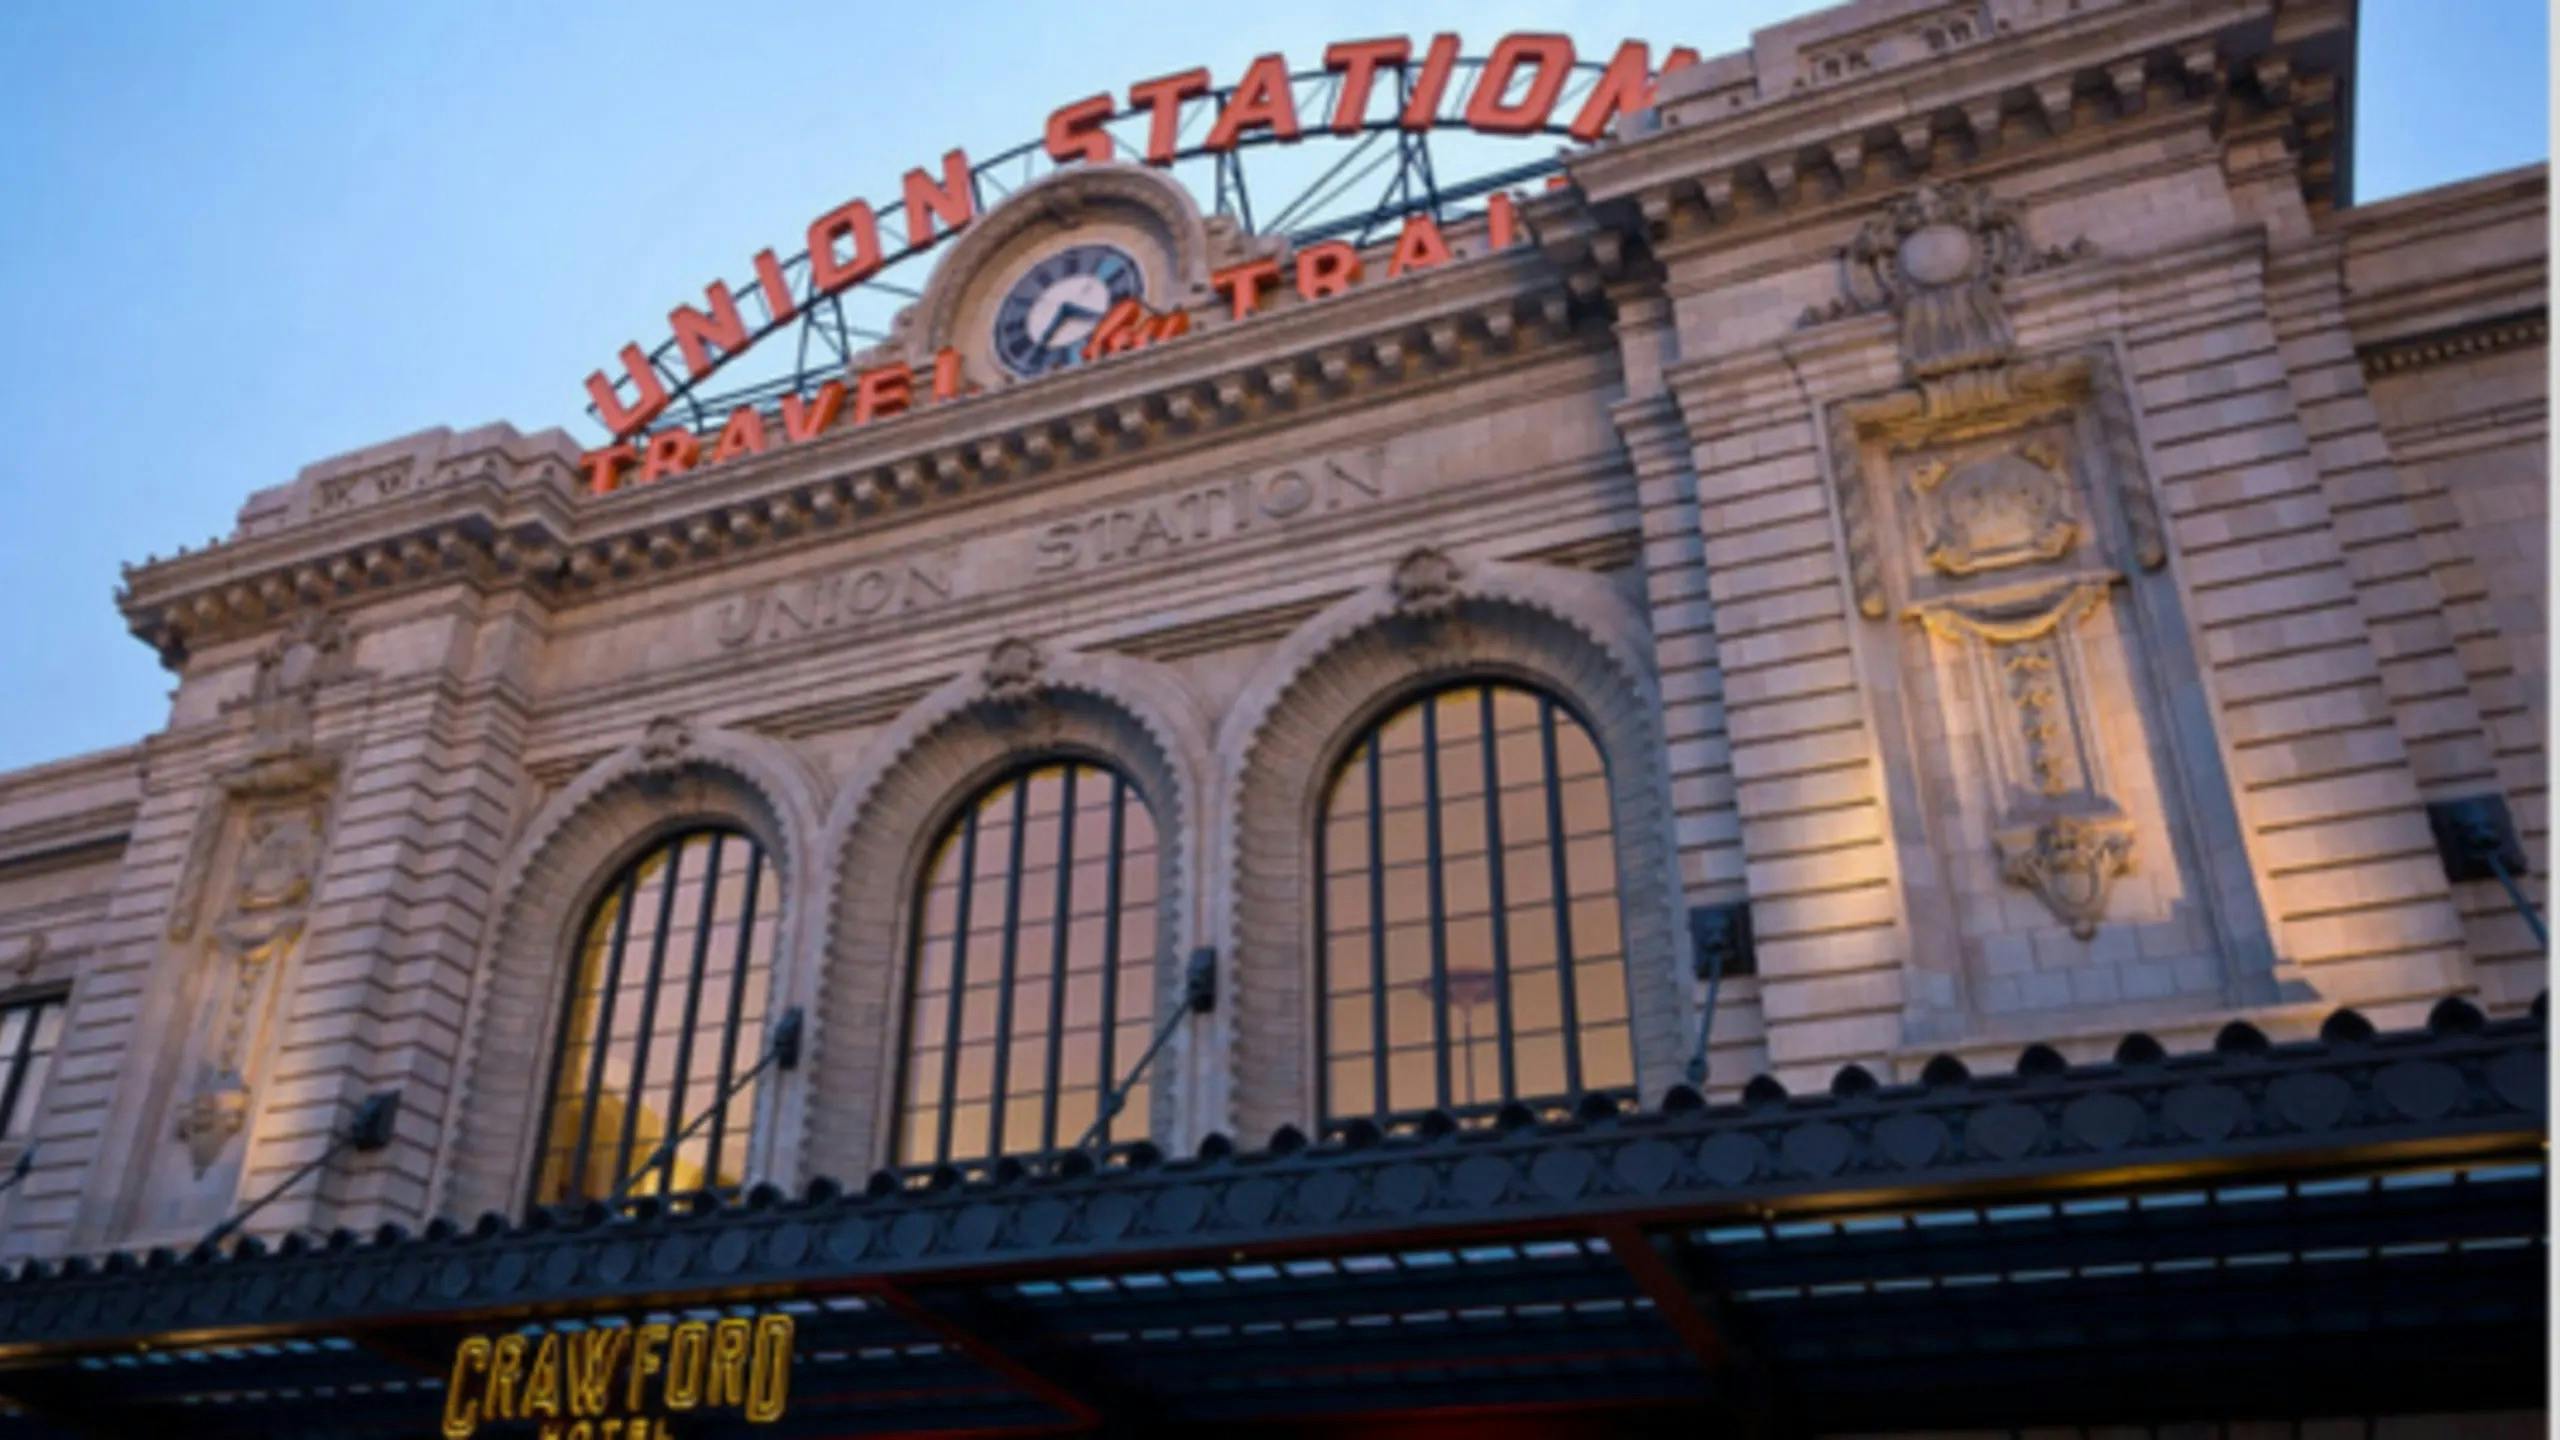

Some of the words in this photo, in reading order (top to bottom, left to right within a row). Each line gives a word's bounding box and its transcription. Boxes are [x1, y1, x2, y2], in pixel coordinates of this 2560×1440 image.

[583, 148, 977, 439] UNION
[1045, 31, 1699, 167] STATION
[1211, 175, 1568, 320] TRAI
[717, 565, 956, 649] UNION
[1035, 448, 1386, 575] STATION
[442, 1314, 795, 1439] CRAWFORD
